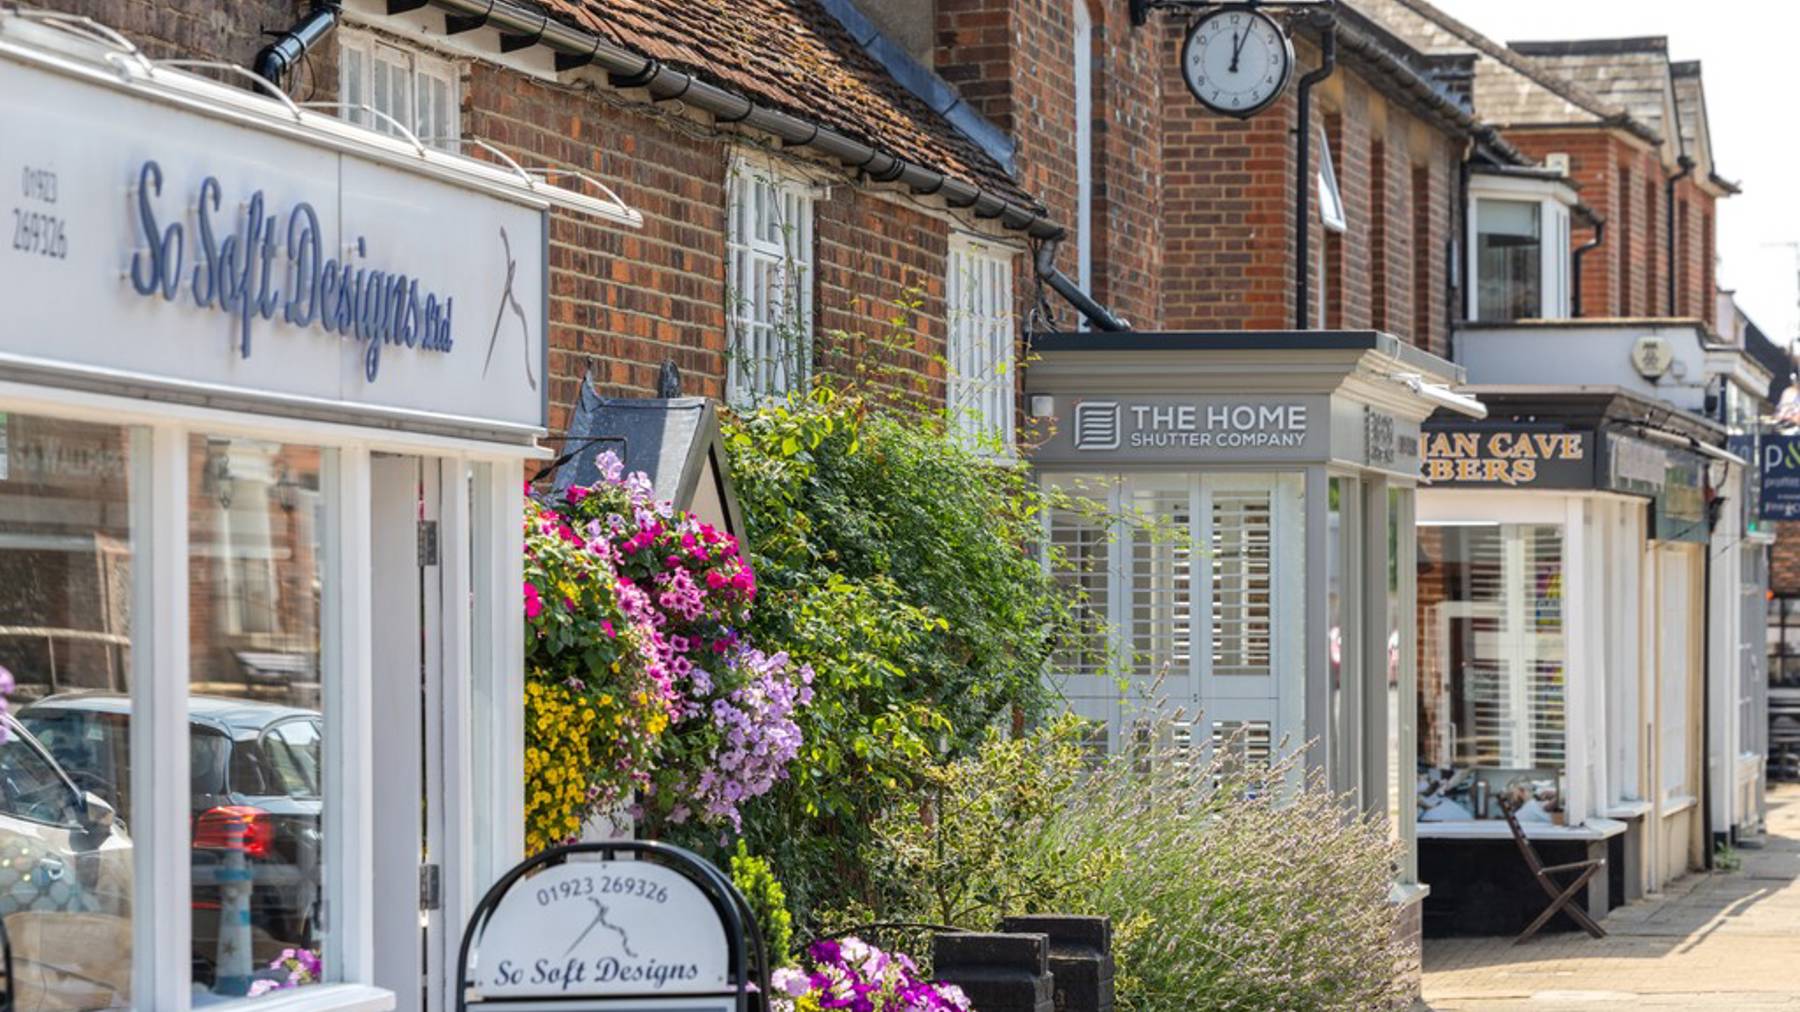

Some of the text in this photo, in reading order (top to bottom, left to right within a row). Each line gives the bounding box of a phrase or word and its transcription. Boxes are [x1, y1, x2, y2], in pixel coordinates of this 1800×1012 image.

[1230, 14, 1240, 25] 12
[21, 166, 57, 204] 01923
[12, 207, 69, 260] 269326
[130, 159, 183, 301] So
[191, 175, 279, 359] Soft
[284, 201, 419, 383] Designs
[1130, 405, 1307, 431] THE HOME
[1130, 432, 1306, 447] SHUTTER COMPANY
[1487, 432, 1584, 460] CAVE
[535, 875, 670, 908] 01923 269326
[493, 955, 699, 991] So Soft Designs
